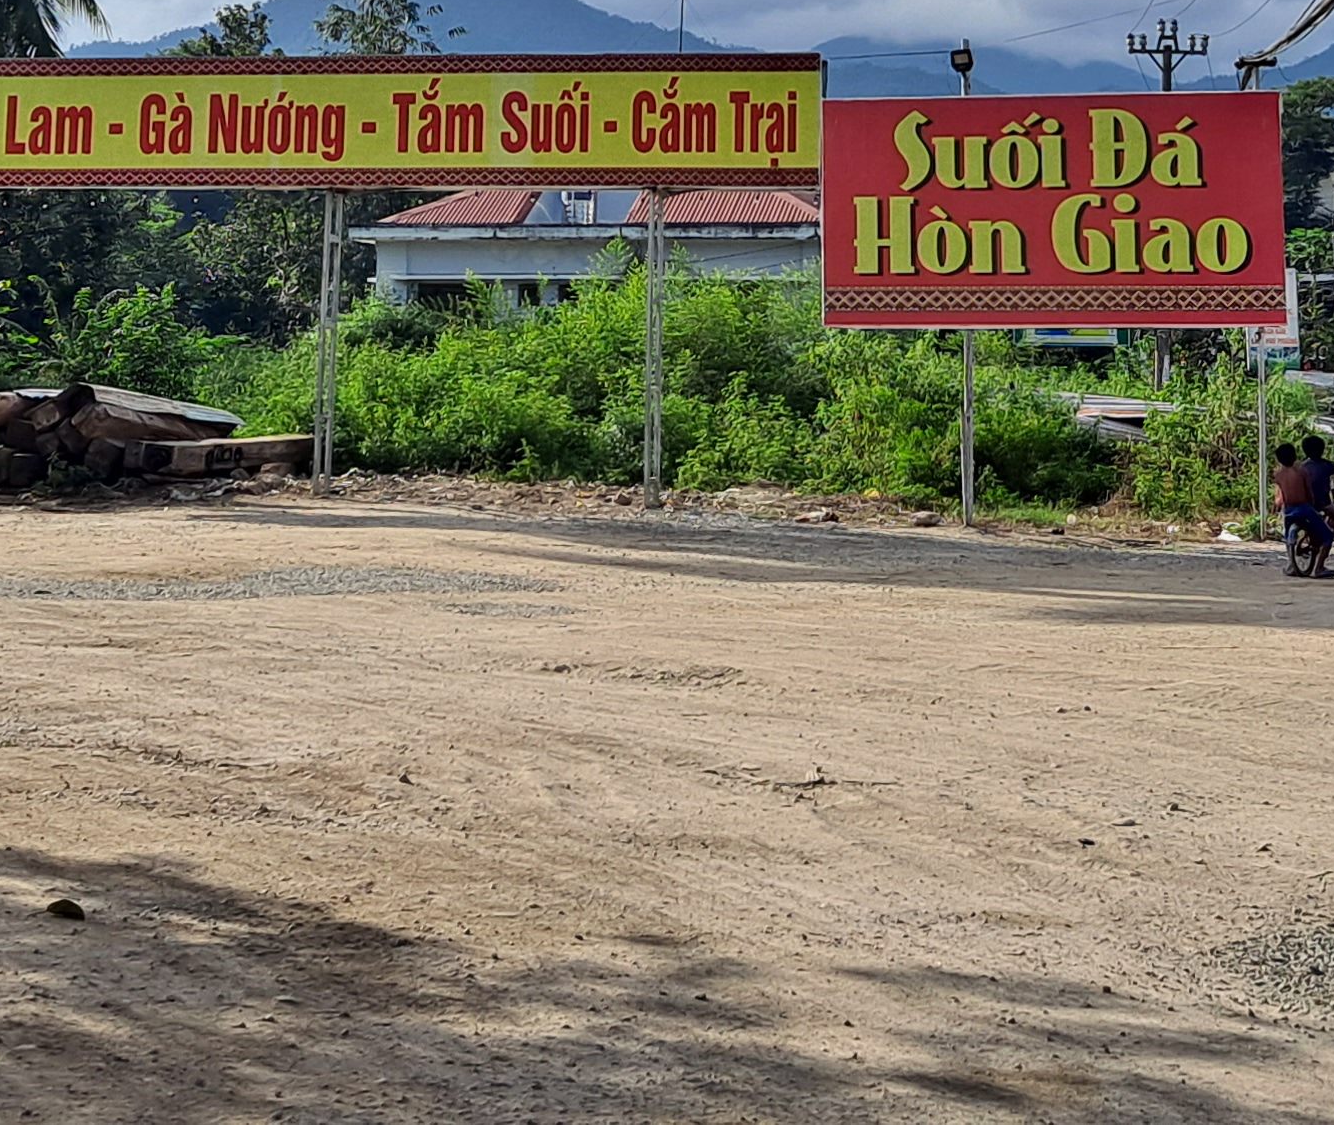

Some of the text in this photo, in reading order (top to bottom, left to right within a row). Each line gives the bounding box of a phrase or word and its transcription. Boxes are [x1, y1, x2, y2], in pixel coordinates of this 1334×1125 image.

[5, 95, 93, 156] Lam
[109, 122, 124, 135] -
[139, 92, 193, 155] Gà
[207, 91, 346, 162] Nướng
[361, 121, 376, 133] -
[392, 78, 485, 154] Tắm
[500, 81, 591, 154] Suối
[604, 120, 618, 133] -
[631, 77, 717, 153] Cắm
[729, 91, 798, 167] Trại
[894, 109, 1202, 191] Suối Đá
[854, 193, 1249, 274] Hòn Giao
